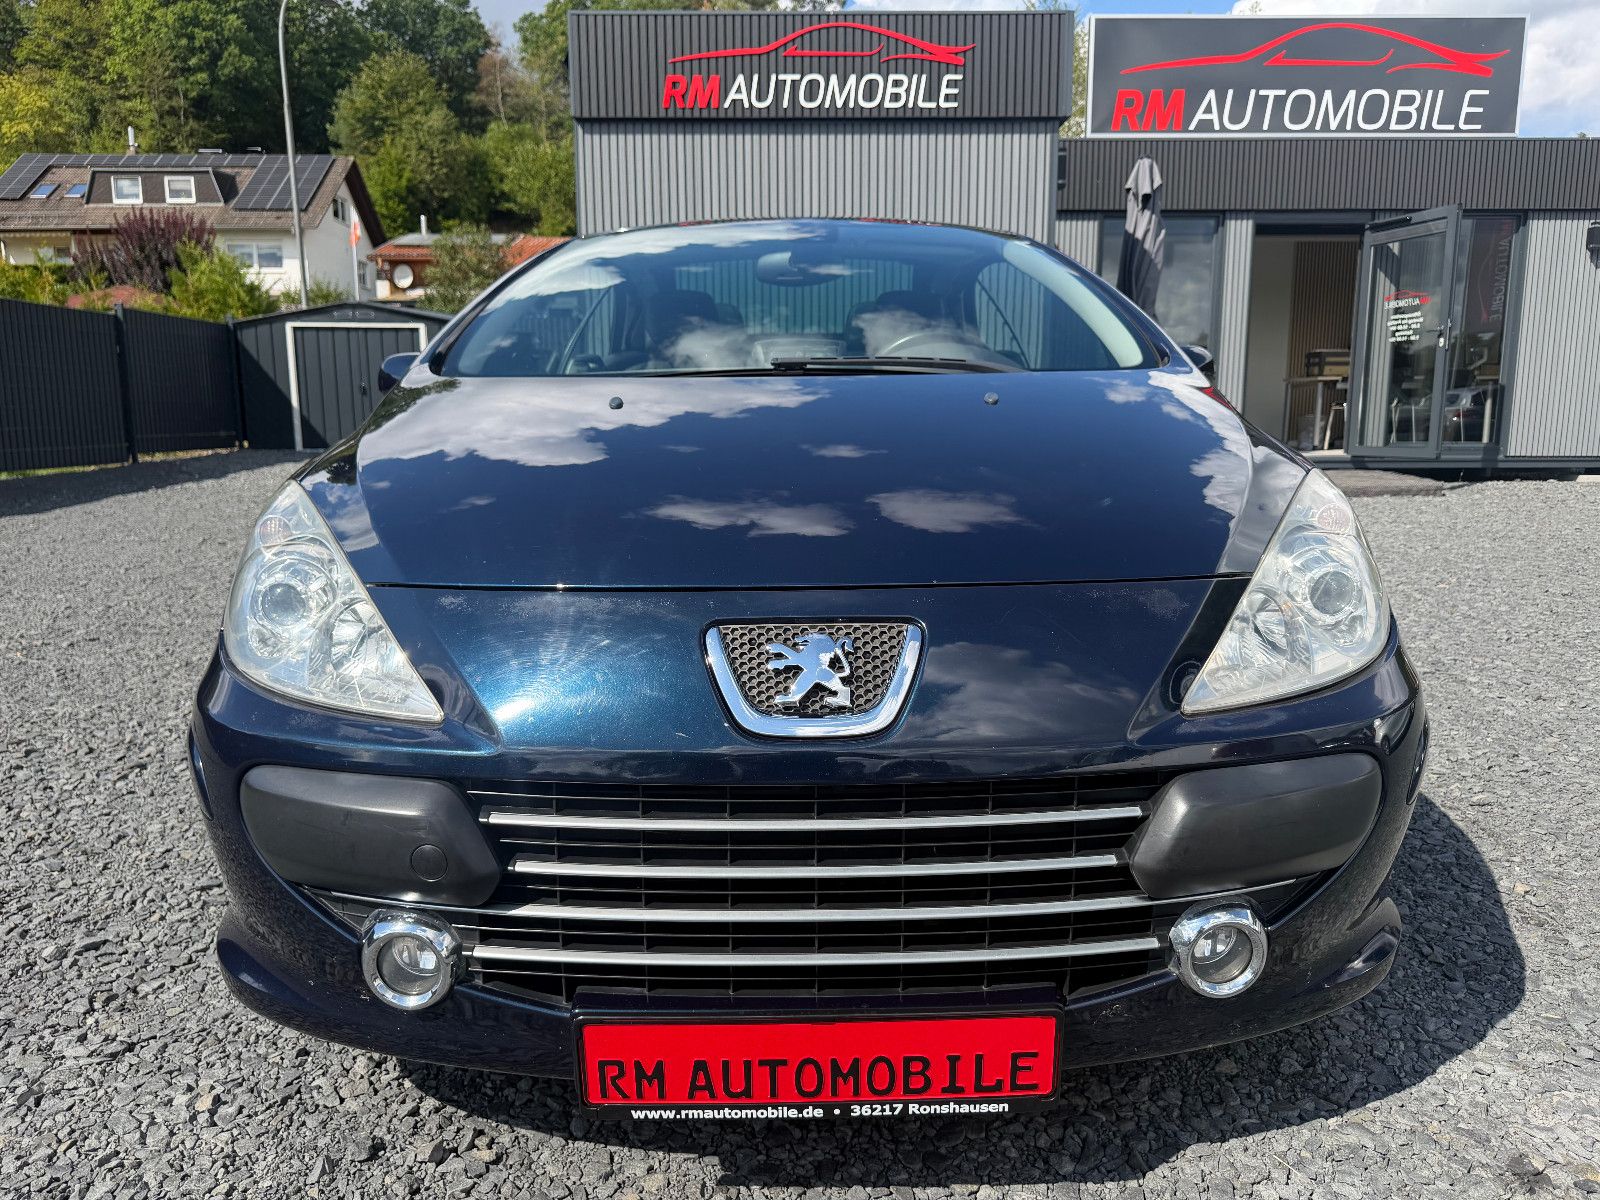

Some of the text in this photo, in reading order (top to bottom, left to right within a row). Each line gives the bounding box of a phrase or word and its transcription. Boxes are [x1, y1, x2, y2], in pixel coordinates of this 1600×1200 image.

[662, 73, 964, 109] RM AUTOMOBILE
[1111, 88, 1490, 131] RM AUTOMOBILE
[598, 1051, 1039, 1099] RM AUTOMOBILE
[631, 1102, 1009, 1119] www.rmautomobile.de 36217 Ronshausen
